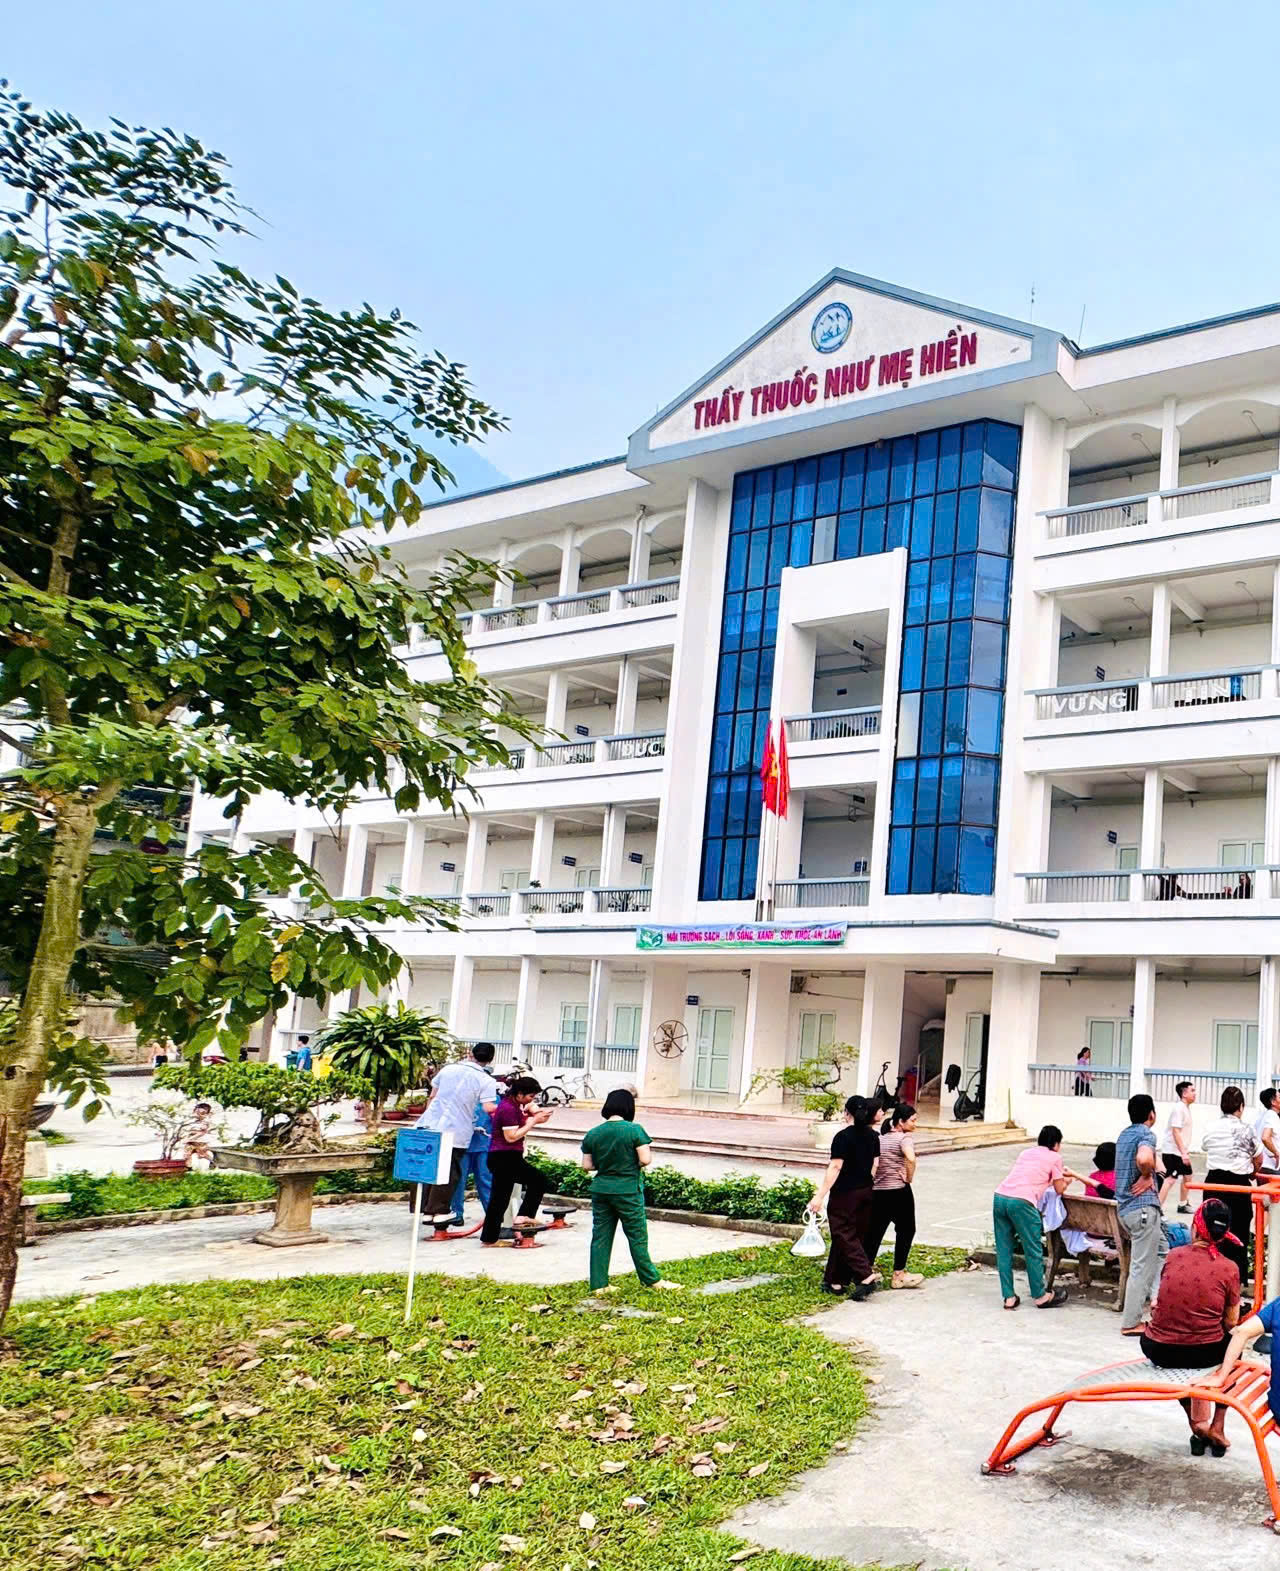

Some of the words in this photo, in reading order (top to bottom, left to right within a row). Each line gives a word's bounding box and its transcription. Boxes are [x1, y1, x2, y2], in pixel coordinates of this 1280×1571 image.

[694, 385, 745, 430] THẦY
[750, 365, 818, 417] THUỐC
[824, 354, 875, 400] NHƯ
[878, 347, 914, 389] MẸ
[919, 323, 978, 377] HIỀN
